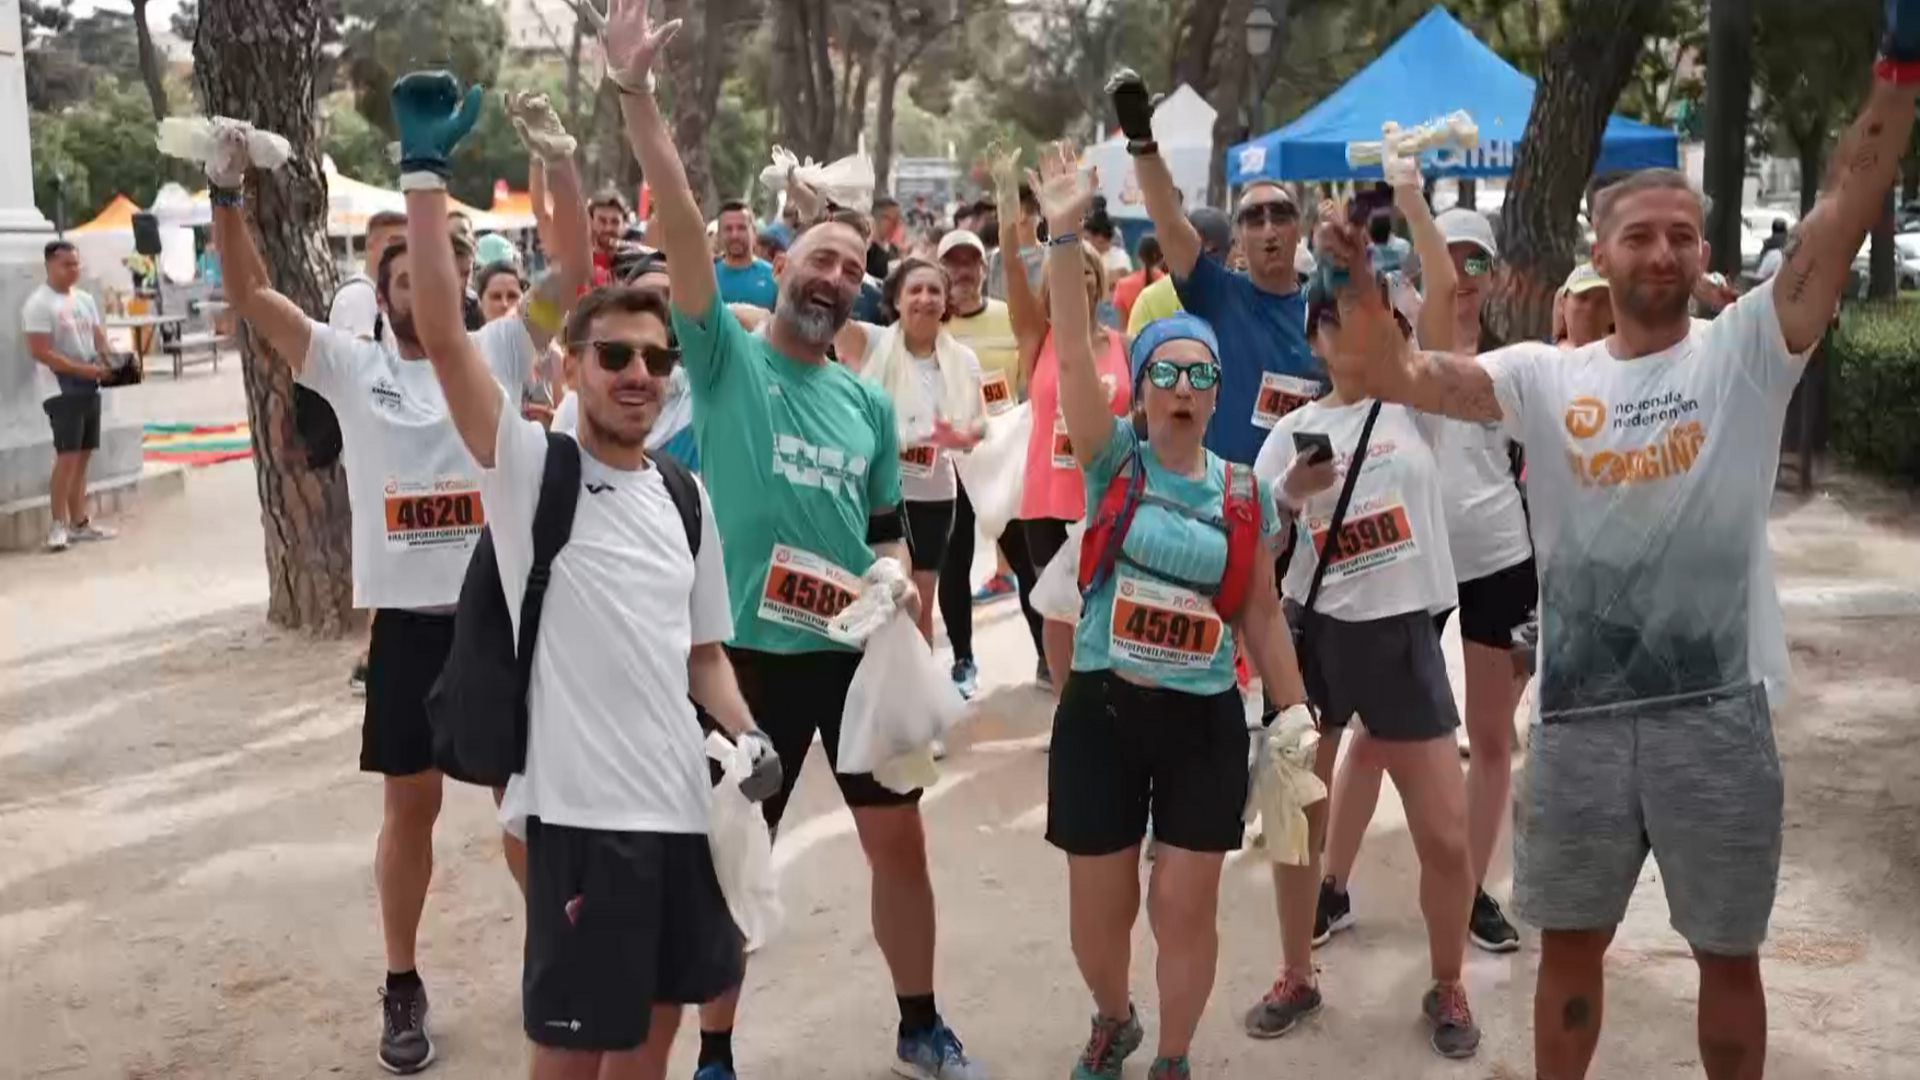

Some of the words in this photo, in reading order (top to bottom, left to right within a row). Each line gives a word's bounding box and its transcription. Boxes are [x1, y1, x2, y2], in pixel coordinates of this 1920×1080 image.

[396, 494, 473, 530] 4620
[1325, 512, 1400, 560] 598
[1125, 605, 1205, 651] 4591
